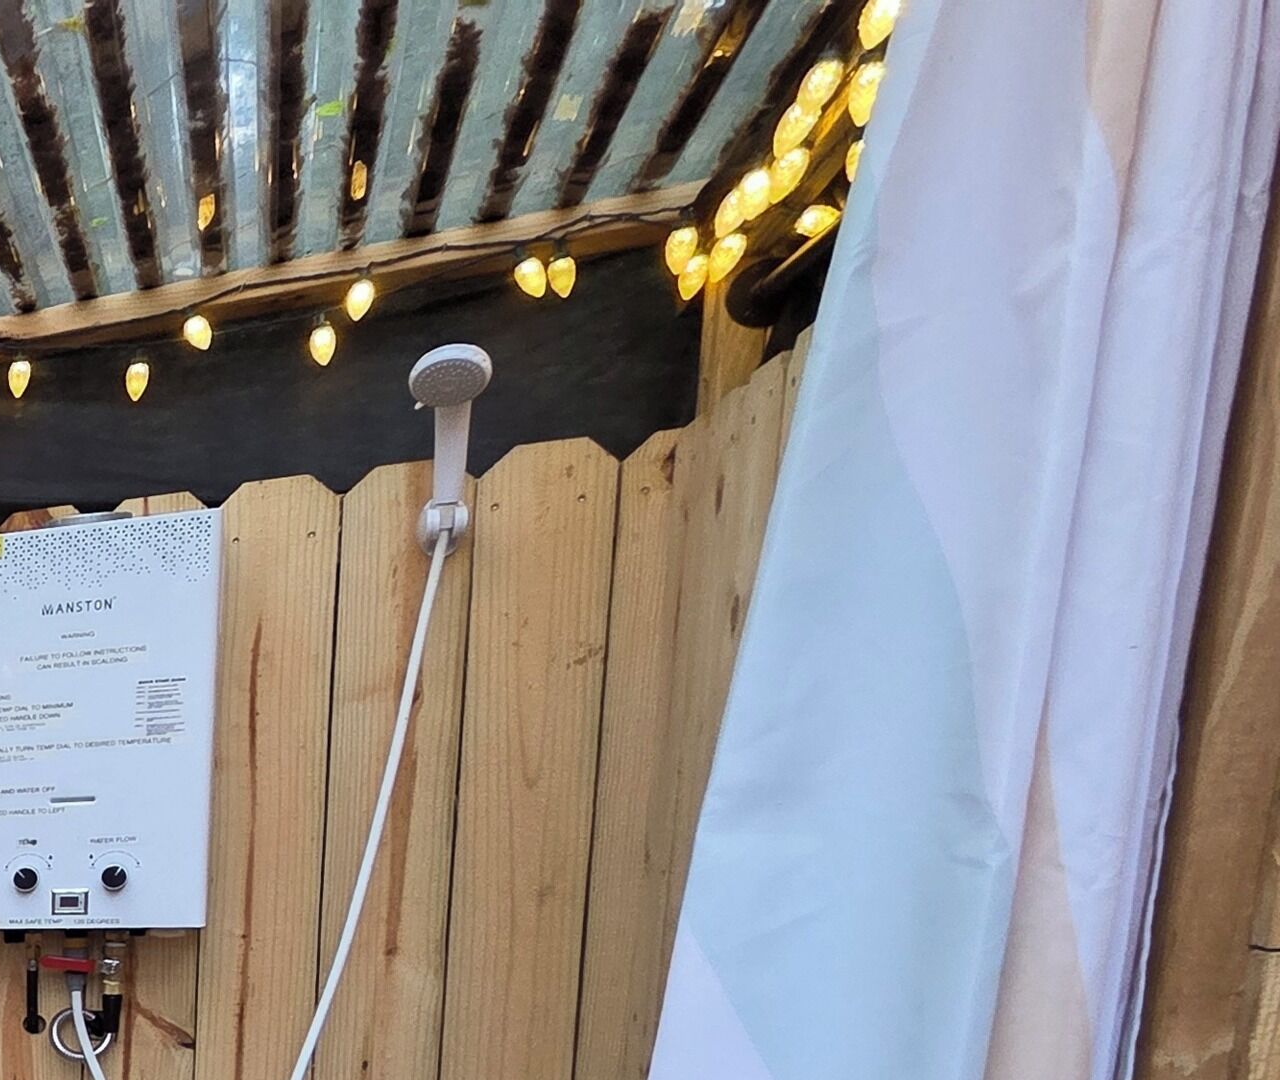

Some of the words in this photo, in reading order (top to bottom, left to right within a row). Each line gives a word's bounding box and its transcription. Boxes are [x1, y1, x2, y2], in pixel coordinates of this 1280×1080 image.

[41, 598, 113, 616] MANSTON
[60, 631, 95, 639] WARNING
[20, 654, 49, 662] FAILURE
[62, 650, 91, 658] FOLLOW
[93, 645, 147, 656] INSTRUCTIONS
[53, 661, 81, 669] RESULT
[91, 656, 128, 666] SCALDING
[42, 702, 74, 710] MINIMUM
[85, 740, 116, 748] DESIRED
[118, 737, 172, 746] TEMPERATURE
